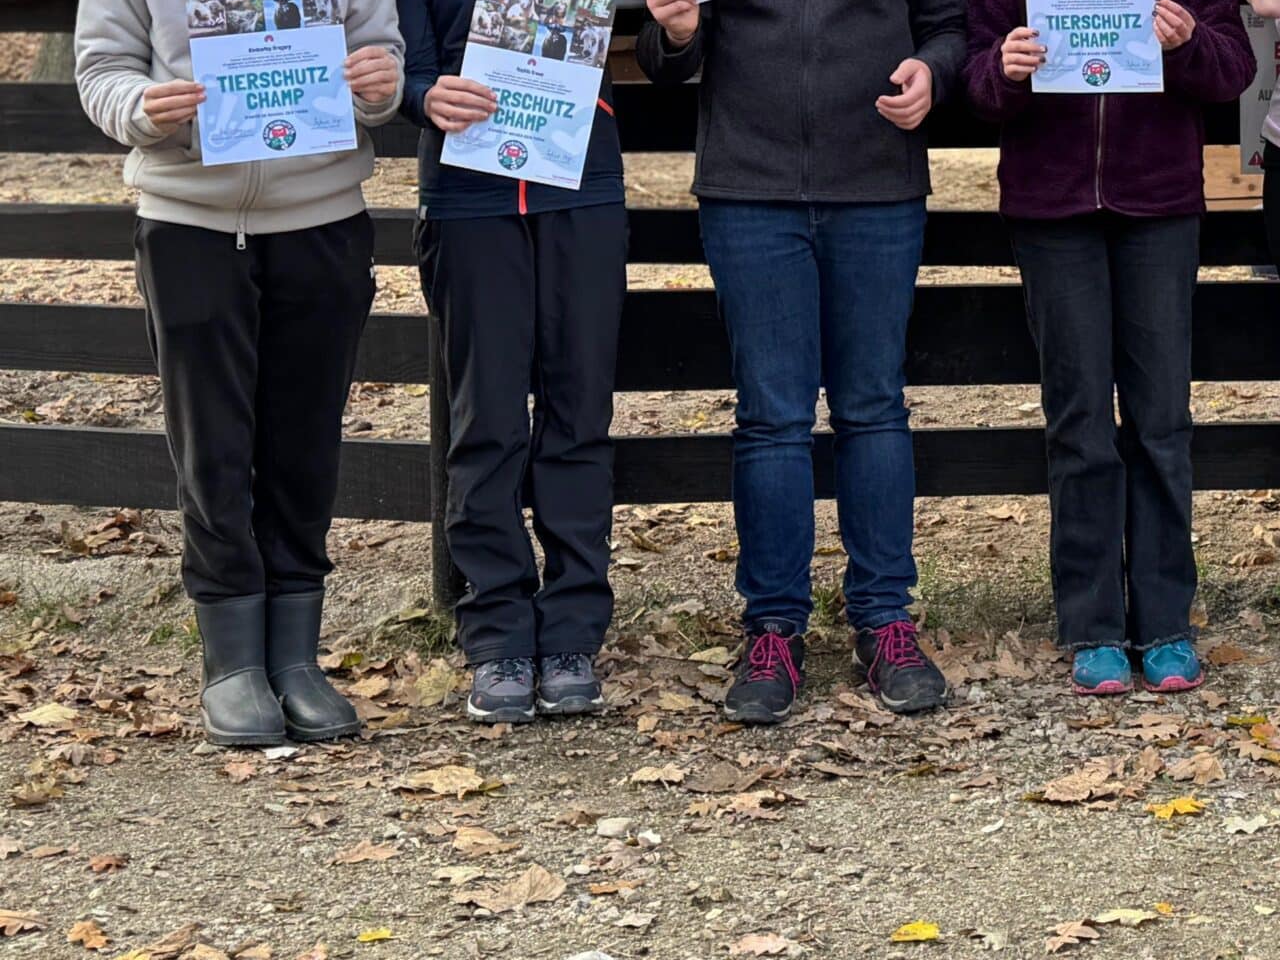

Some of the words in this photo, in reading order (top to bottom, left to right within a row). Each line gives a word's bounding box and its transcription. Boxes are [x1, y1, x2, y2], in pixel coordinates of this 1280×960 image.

[1045, 13, 1142, 30] TIERSCHUTZ
[1069, 31, 1120, 48] CHAMP
[217, 66, 329, 93] TIERSCHUTZ
[246, 87, 305, 110] CHAMP
[491, 87, 575, 119] RSCHUTZ
[493, 106, 547, 132] CHAMP
